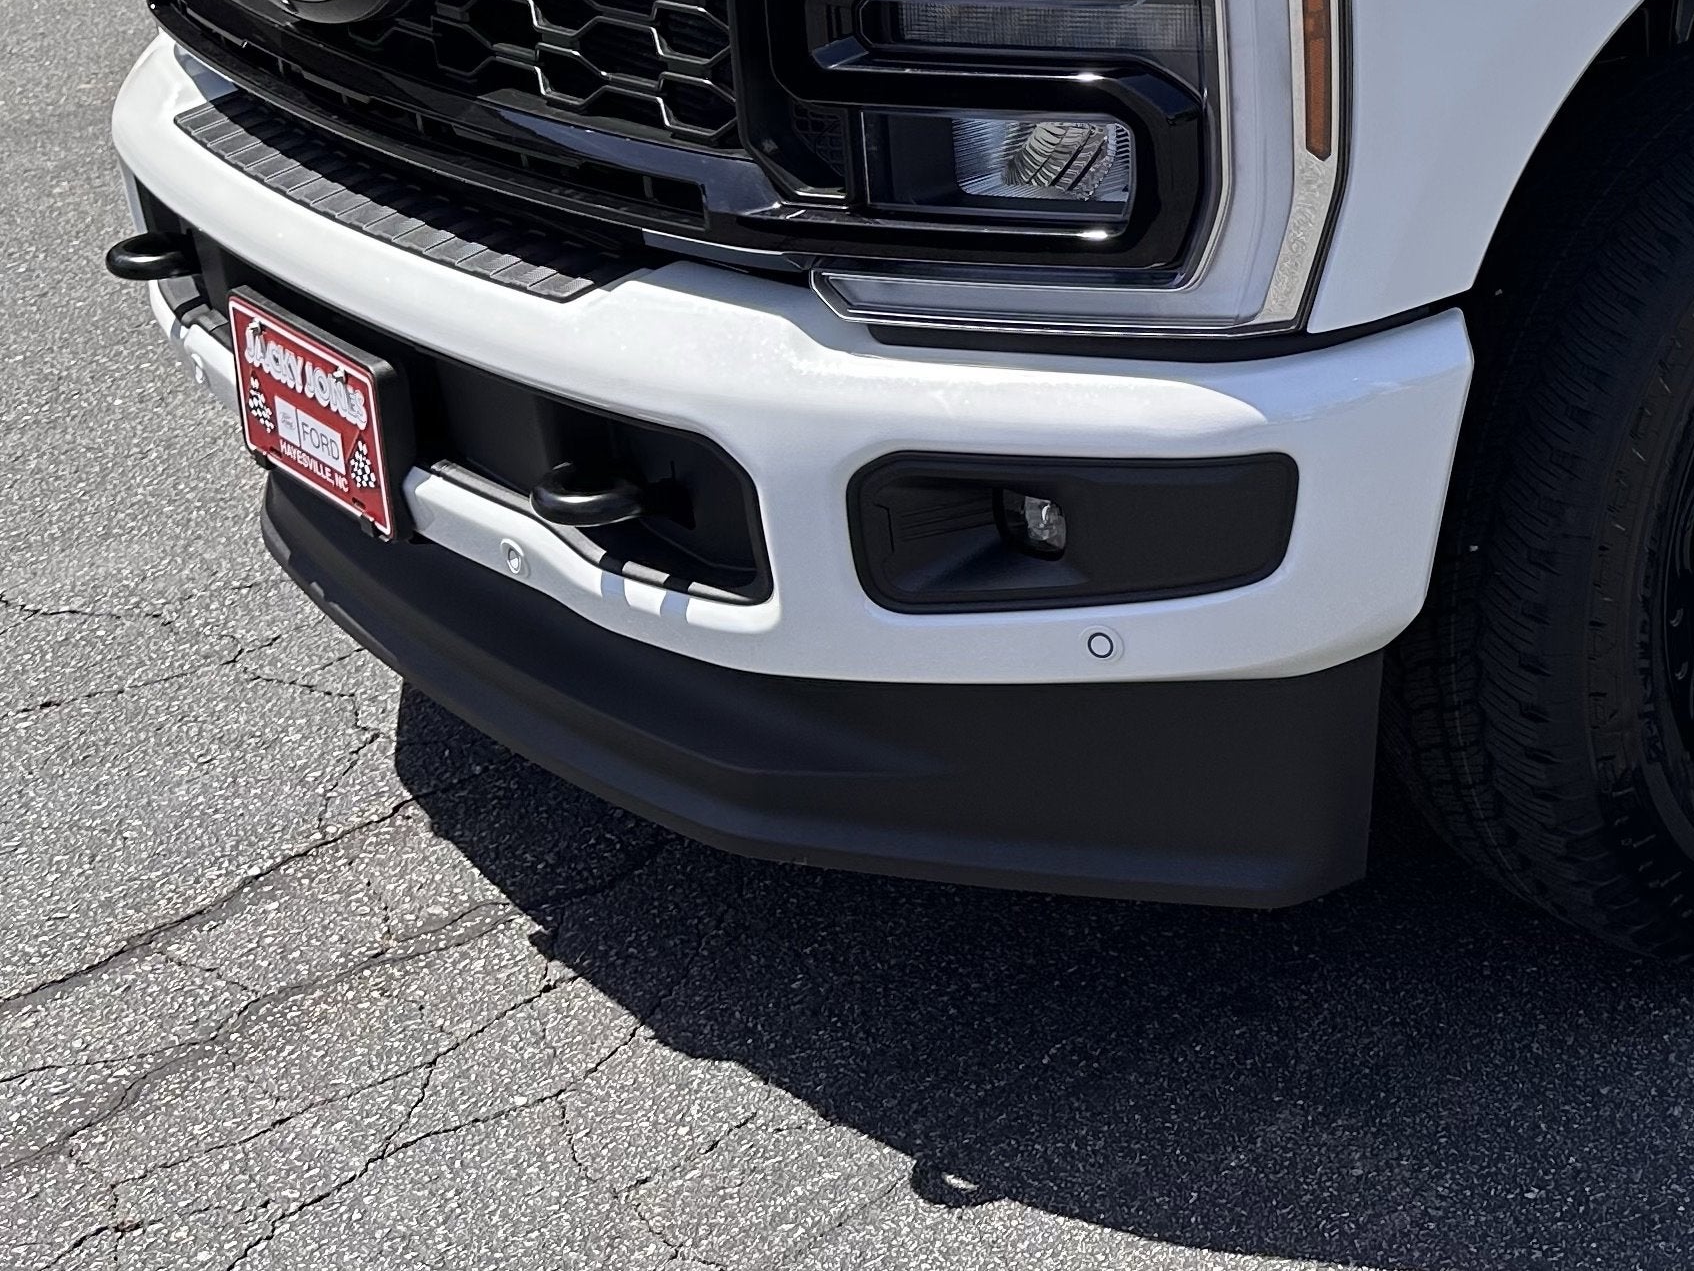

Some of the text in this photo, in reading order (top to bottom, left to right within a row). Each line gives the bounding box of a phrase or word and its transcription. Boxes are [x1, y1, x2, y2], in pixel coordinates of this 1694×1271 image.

[245, 328, 368, 431] JACKY JONES
[301, 421, 340, 461] FORD
[333, 472, 350, 493] NC
